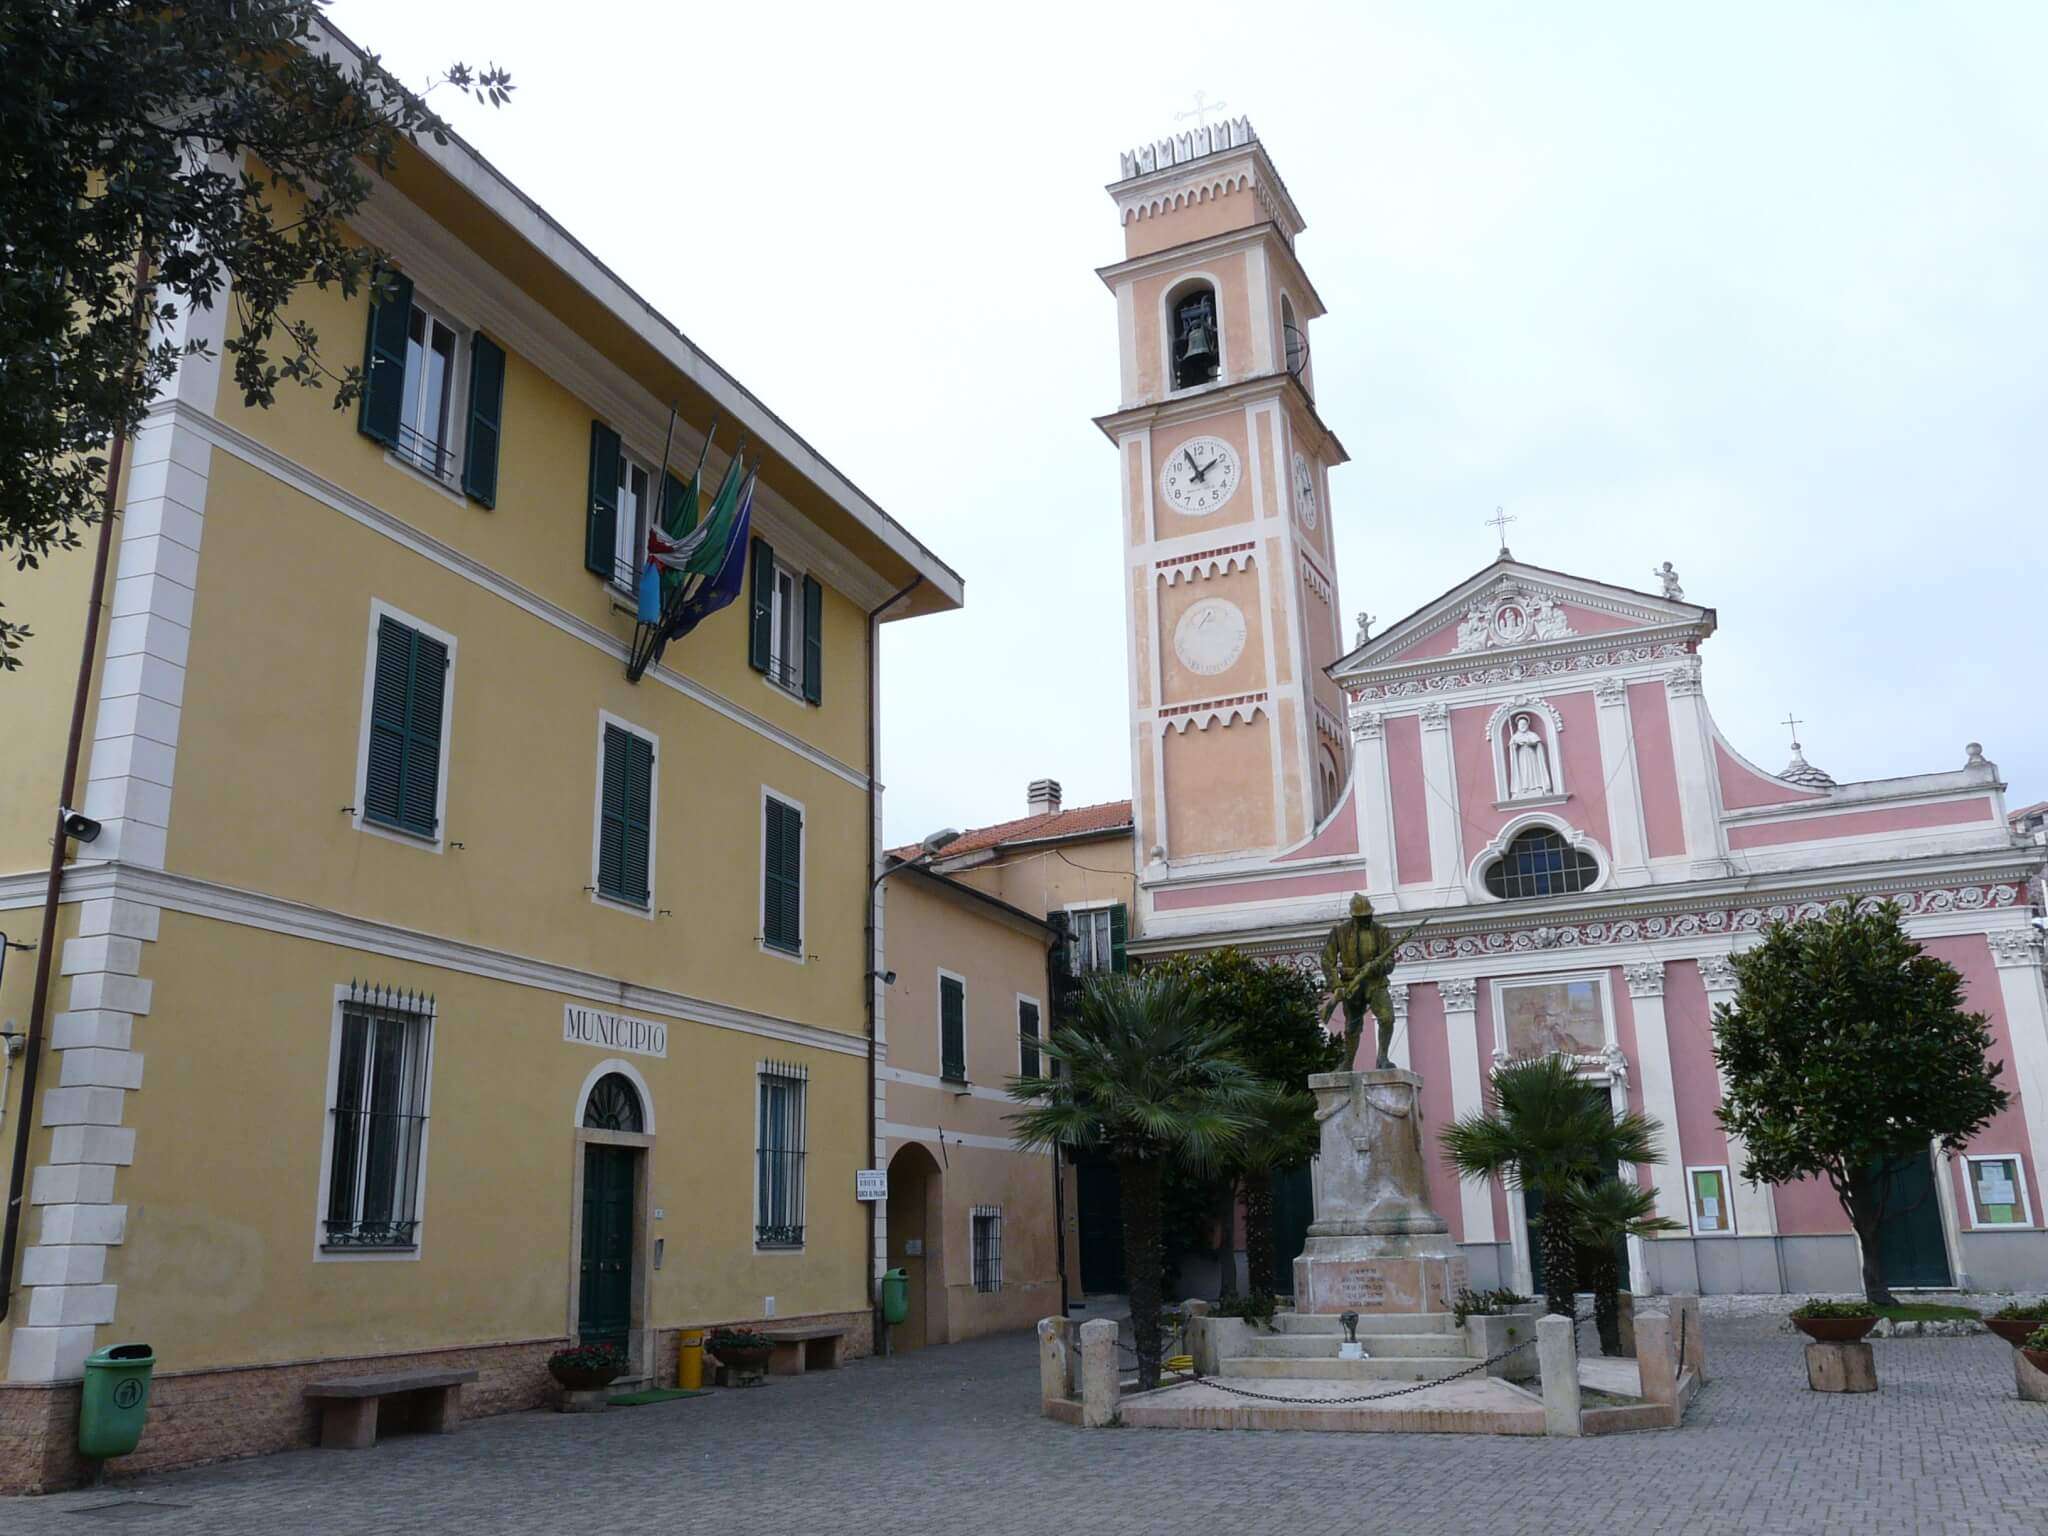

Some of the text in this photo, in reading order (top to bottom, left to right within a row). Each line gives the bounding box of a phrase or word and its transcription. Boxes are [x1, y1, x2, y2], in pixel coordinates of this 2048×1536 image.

[1194, 446, 1204, 456] 12
[1210, 446, 1215, 455] 1
[1218, 453, 1226, 463] 2
[1173, 462, 1183, 473] 10
[1224, 465, 1231, 474] 3
[1169, 477, 1176, 486] 9
[1220, 478, 1227, 488] 4
[1174, 489, 1182, 499] 8
[1212, 489, 1219, 500] 5
[1184, 496, 1191, 506] 7
[1198, 497, 1205, 507] 6
[567, 1009, 664, 1052] MUNICIPIO
